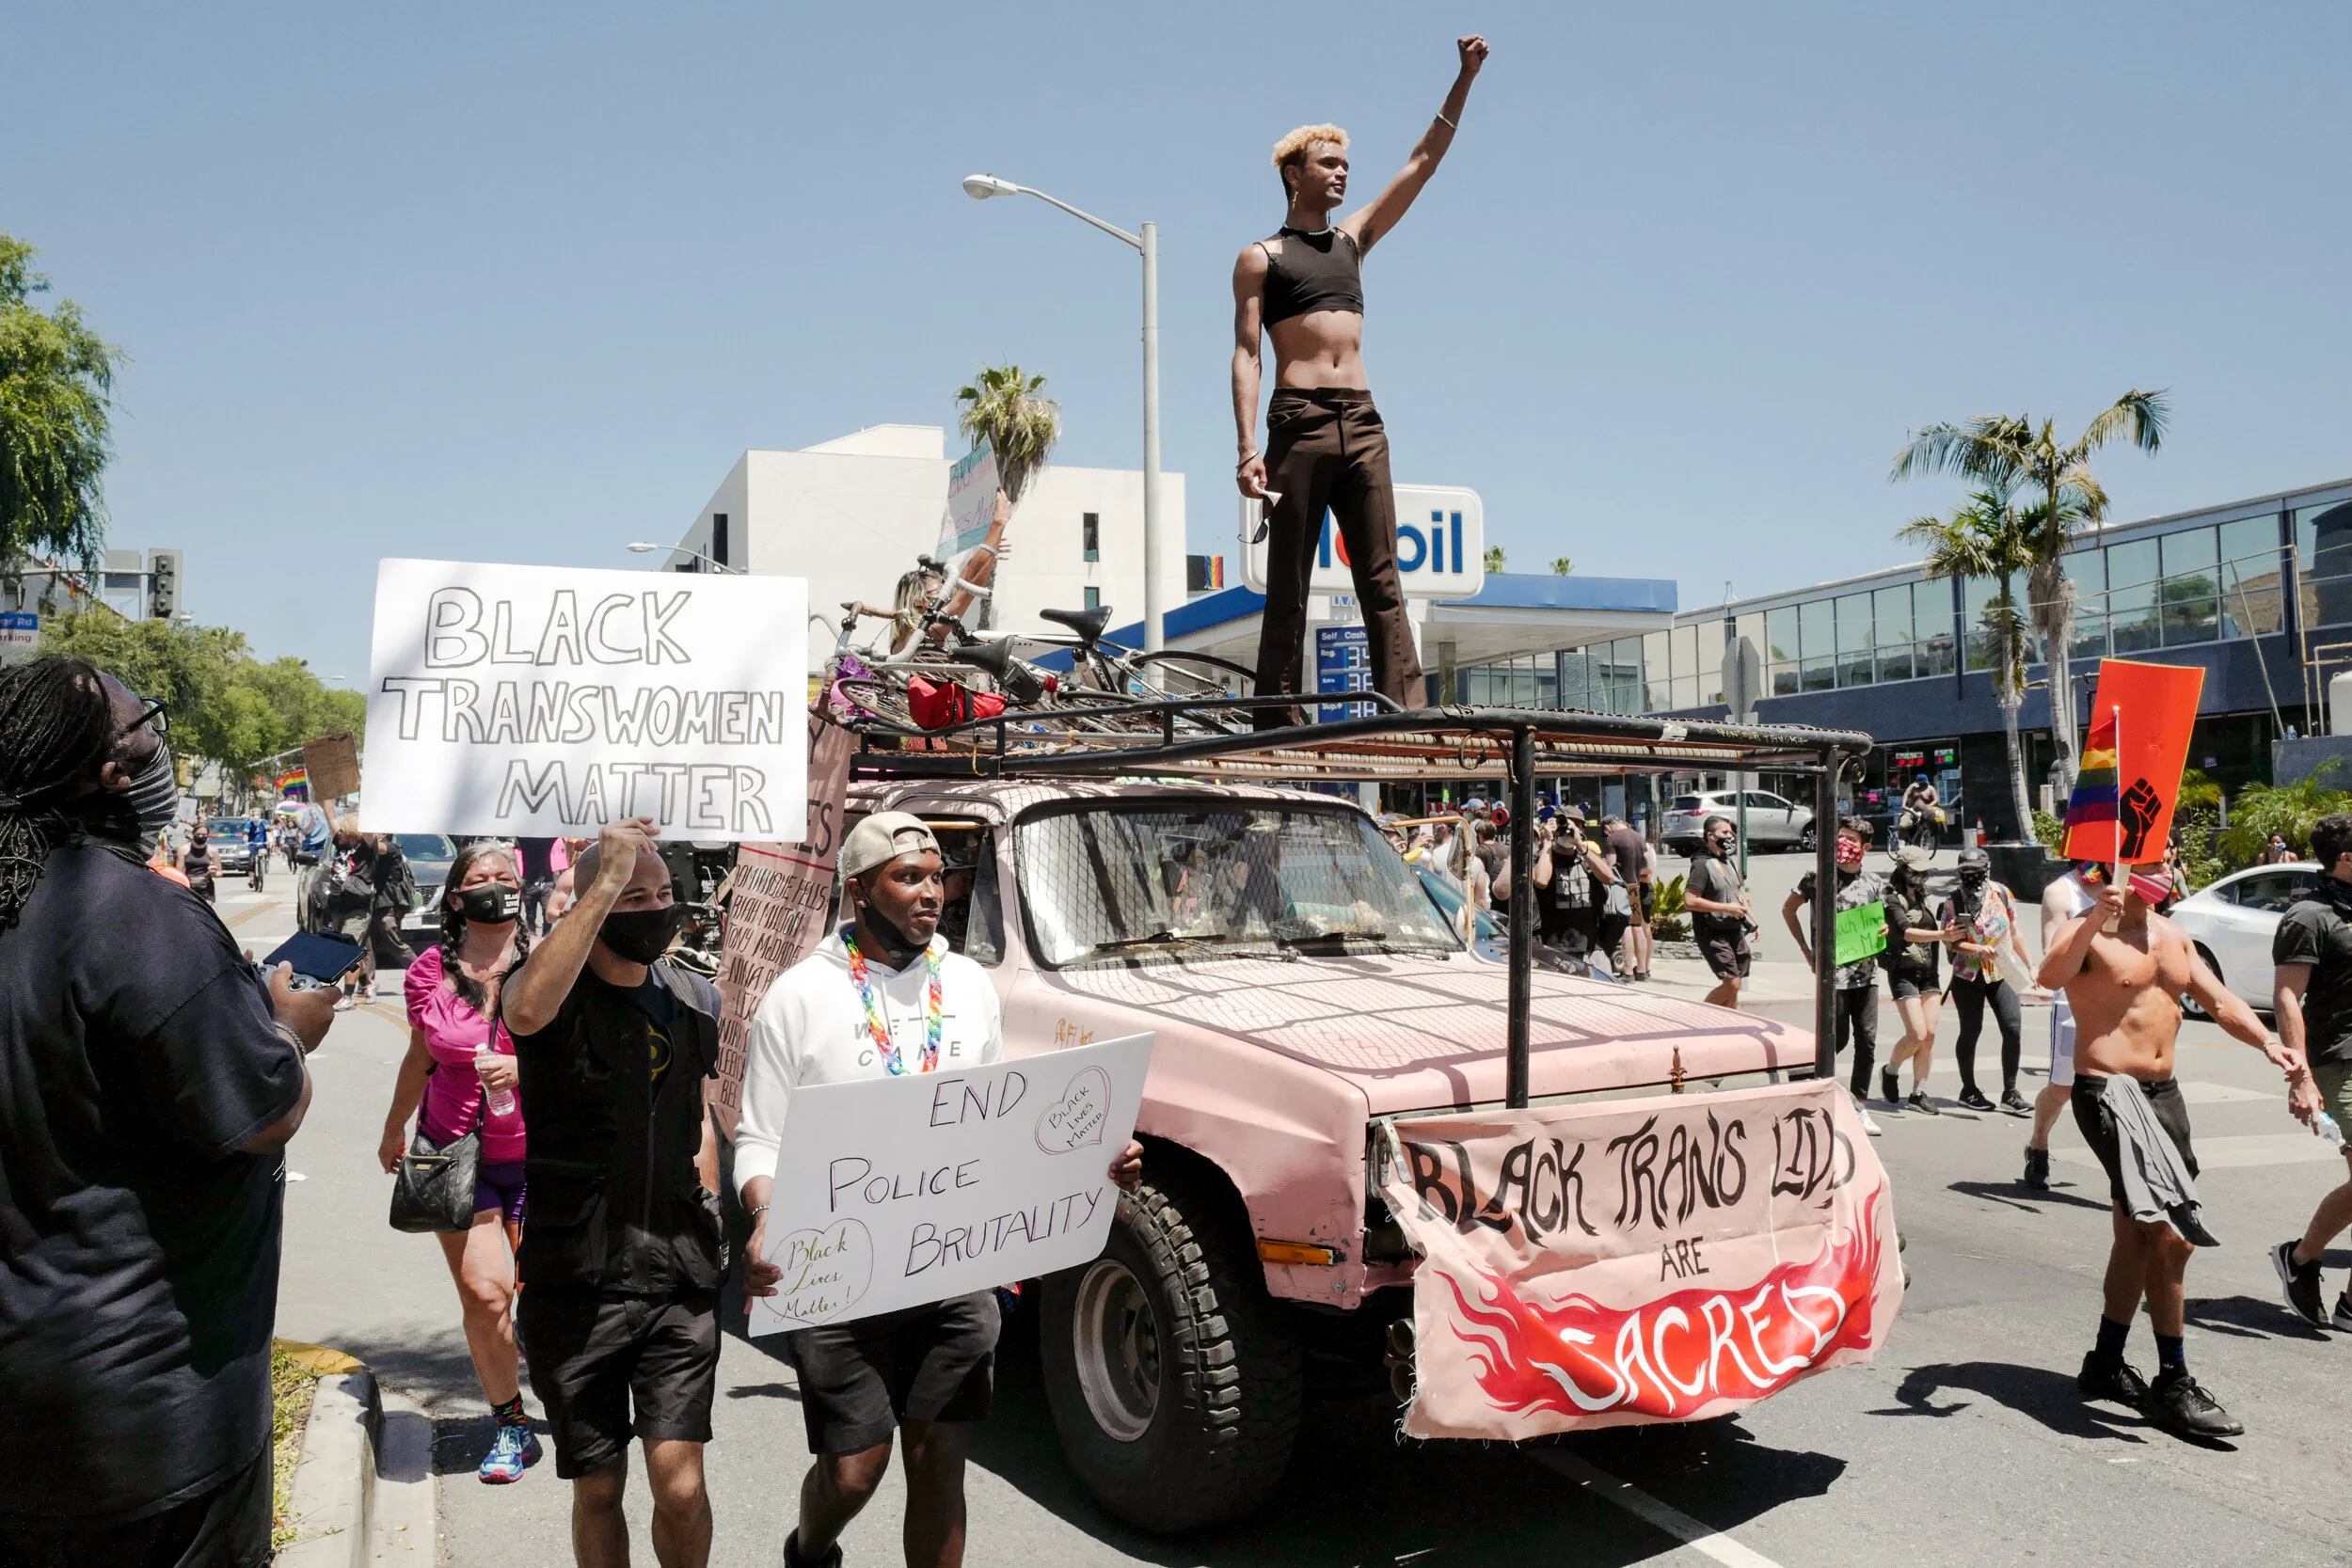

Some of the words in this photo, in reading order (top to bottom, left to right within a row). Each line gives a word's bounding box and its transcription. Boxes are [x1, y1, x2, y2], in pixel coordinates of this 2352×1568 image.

[424, 586, 692, 669] BLACK
[1322, 632, 1338, 641] Self
[1344, 631, 1366, 640] Cash
[381, 677, 784, 747] TRANSWOMEN
[495, 759, 773, 834] MATTER
[930, 1071, 1028, 1128] END
[1048, 1086, 1089, 1129] BLACK
[1067, 1102, 1093, 1130] LIVES
[1066, 1113, 1106, 1148] MATTER
[829, 1158, 981, 1212] POLICE
[1401, 1136, 1601, 1249] BLACK
[1605, 1107, 1747, 1232] TRANS
[787, 1227, 847, 1271] Black
[904, 1187, 1103, 1278] BRUTALITY
[1660, 1235, 1710, 1282] ARE
[785, 1262, 843, 1296] Lives
[1526, 1282, 1846, 1412] SACRED
